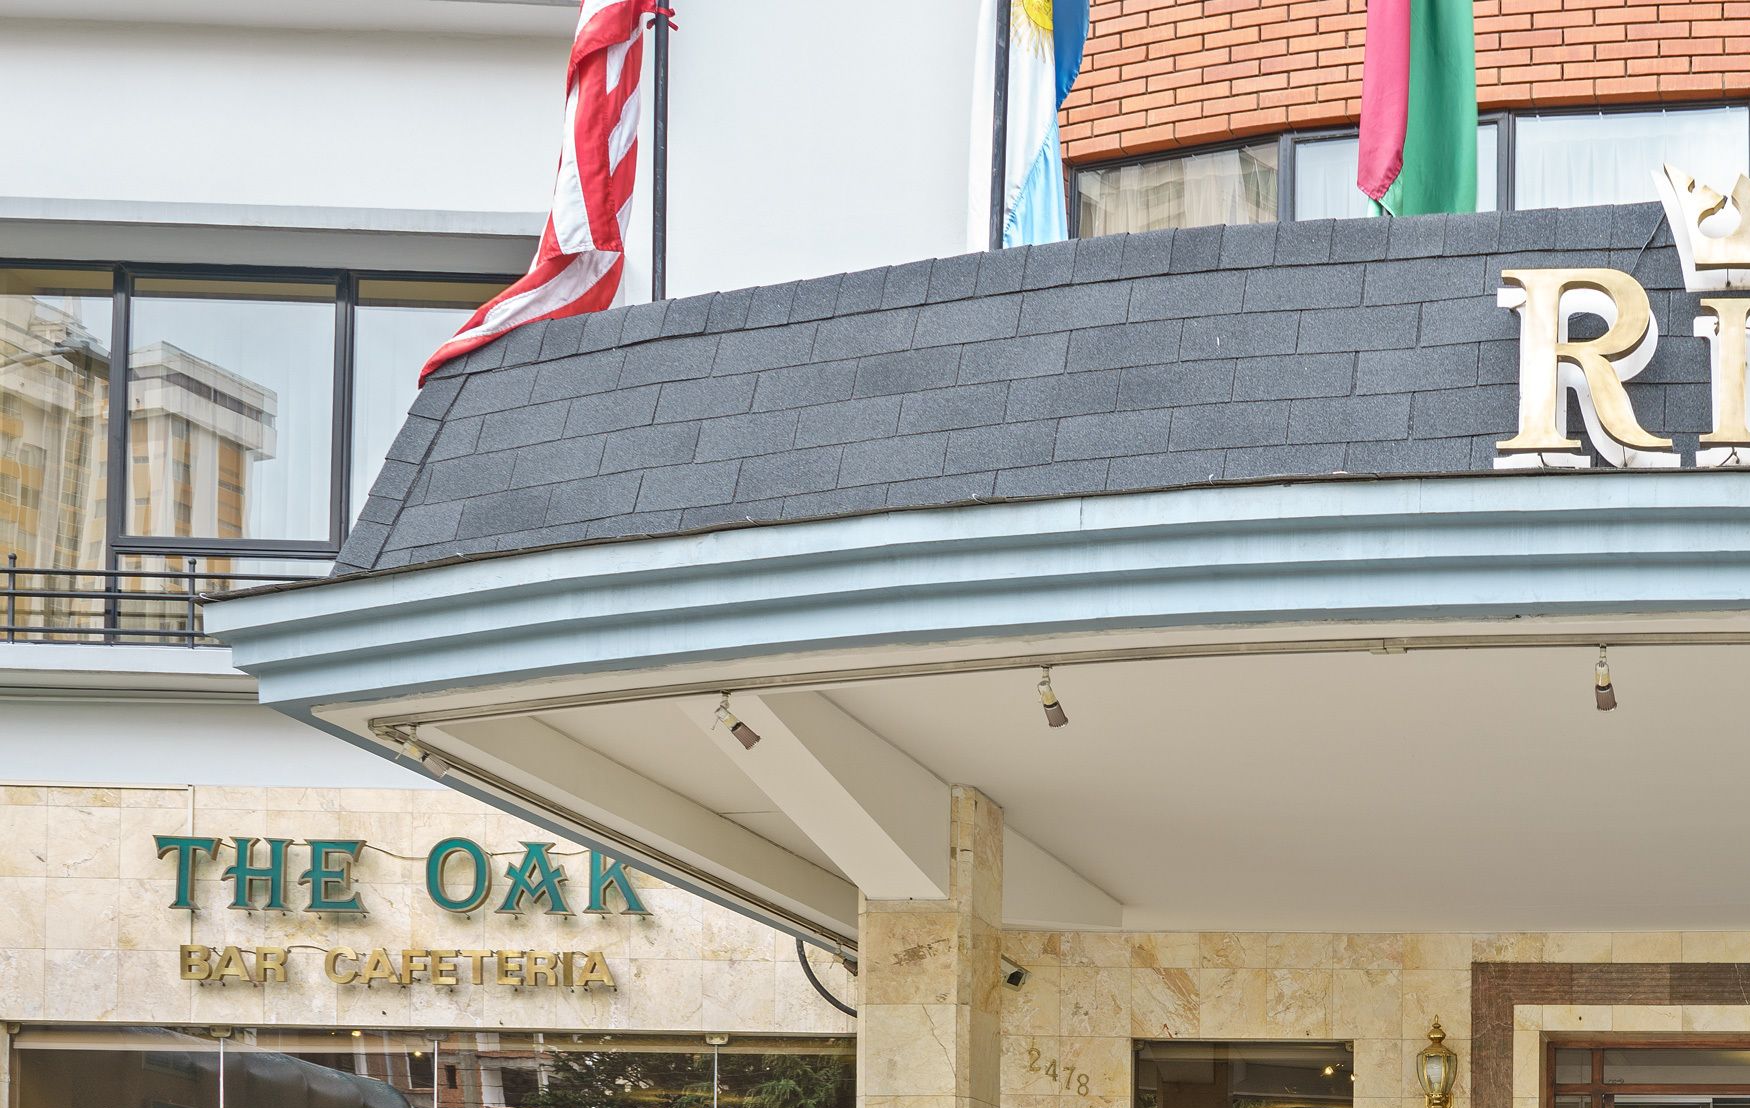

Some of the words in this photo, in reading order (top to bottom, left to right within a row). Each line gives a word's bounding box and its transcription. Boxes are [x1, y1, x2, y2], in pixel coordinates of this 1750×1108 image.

[153, 835, 369, 914] THE
[426, 837, 654, 916] OAK
[180, 944, 291, 983] BAR
[324, 946, 618, 987] CAFETERIA
[1028, 1047, 1090, 1097] 2478
